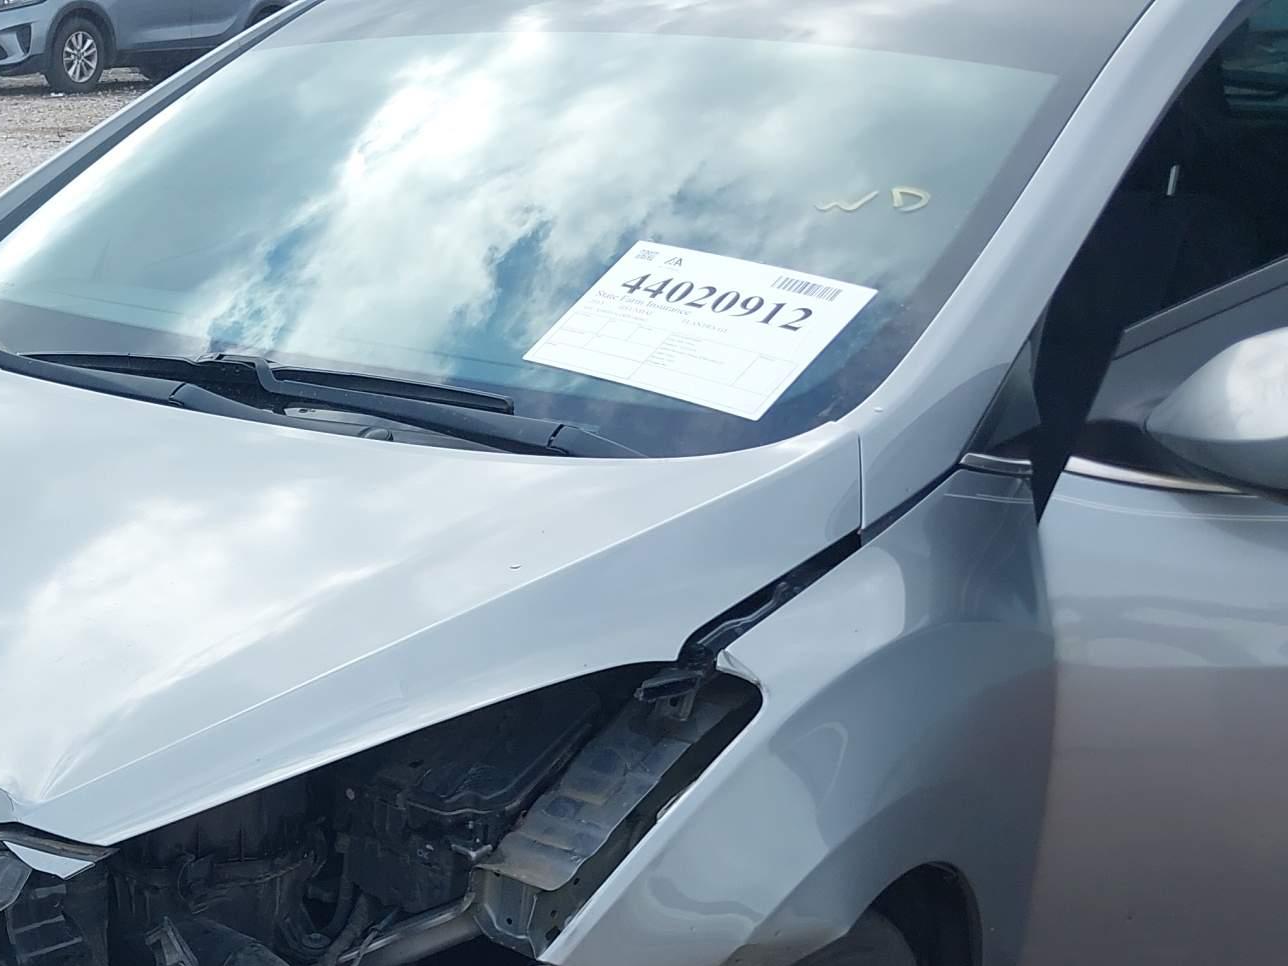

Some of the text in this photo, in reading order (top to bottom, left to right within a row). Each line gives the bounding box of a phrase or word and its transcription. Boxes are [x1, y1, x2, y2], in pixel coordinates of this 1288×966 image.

[596, 289, 619, 302] State
[619, 294, 645, 307] Farm
[646, 300, 693, 316] Insurance
[621, 273, 813, 332] 44020912
